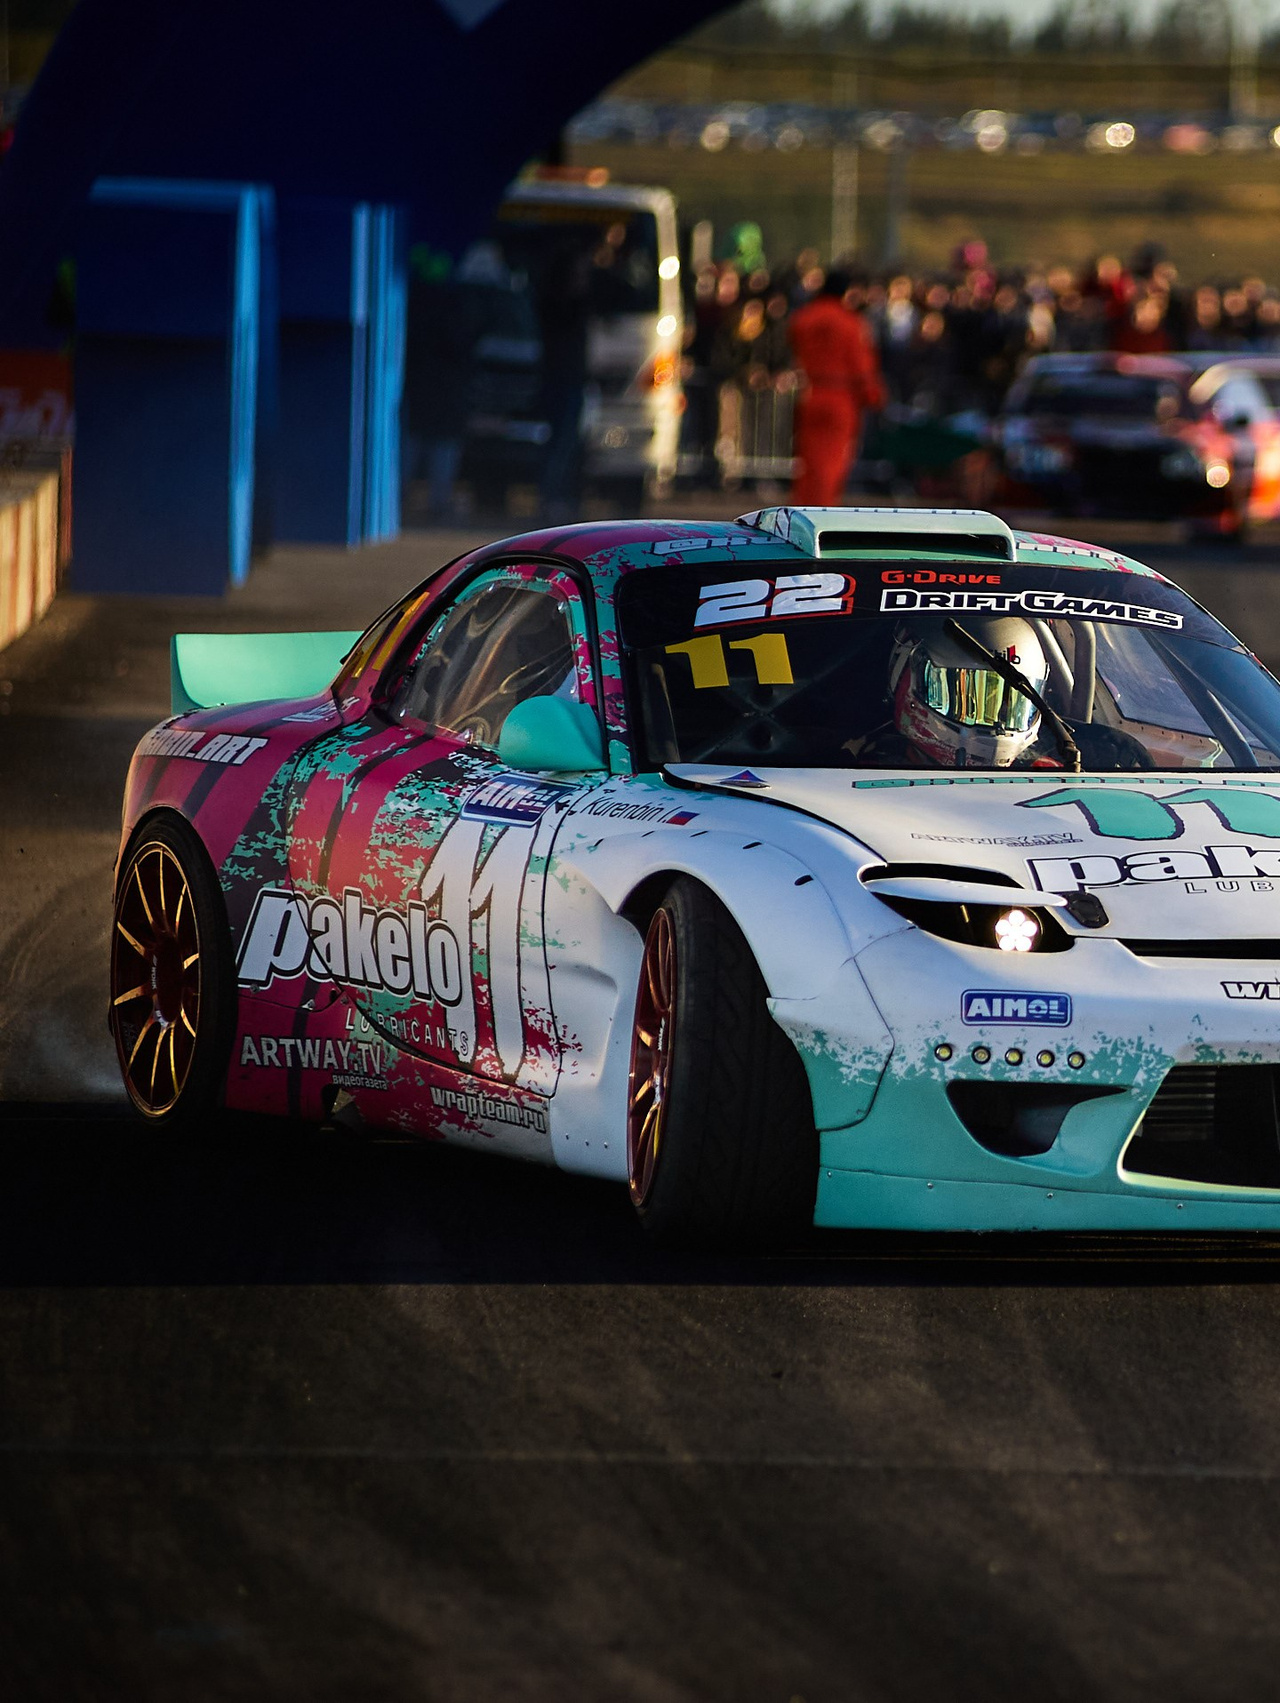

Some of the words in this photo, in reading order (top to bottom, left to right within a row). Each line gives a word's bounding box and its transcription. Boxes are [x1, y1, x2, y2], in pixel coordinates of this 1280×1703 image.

[694, 573, 856, 632] 22
[665, 634, 793, 688] 11
[582, 797, 656, 822] Kurenbin
[236, 887, 464, 1005] pakelo
[345, 1008, 469, 1057] LUBRICANTS
[967, 998, 1065, 1020] AIMOL
[240, 1035, 383, 1075] ARTWAY.TV
[430, 1086, 546, 1133] wrapteam.ru
